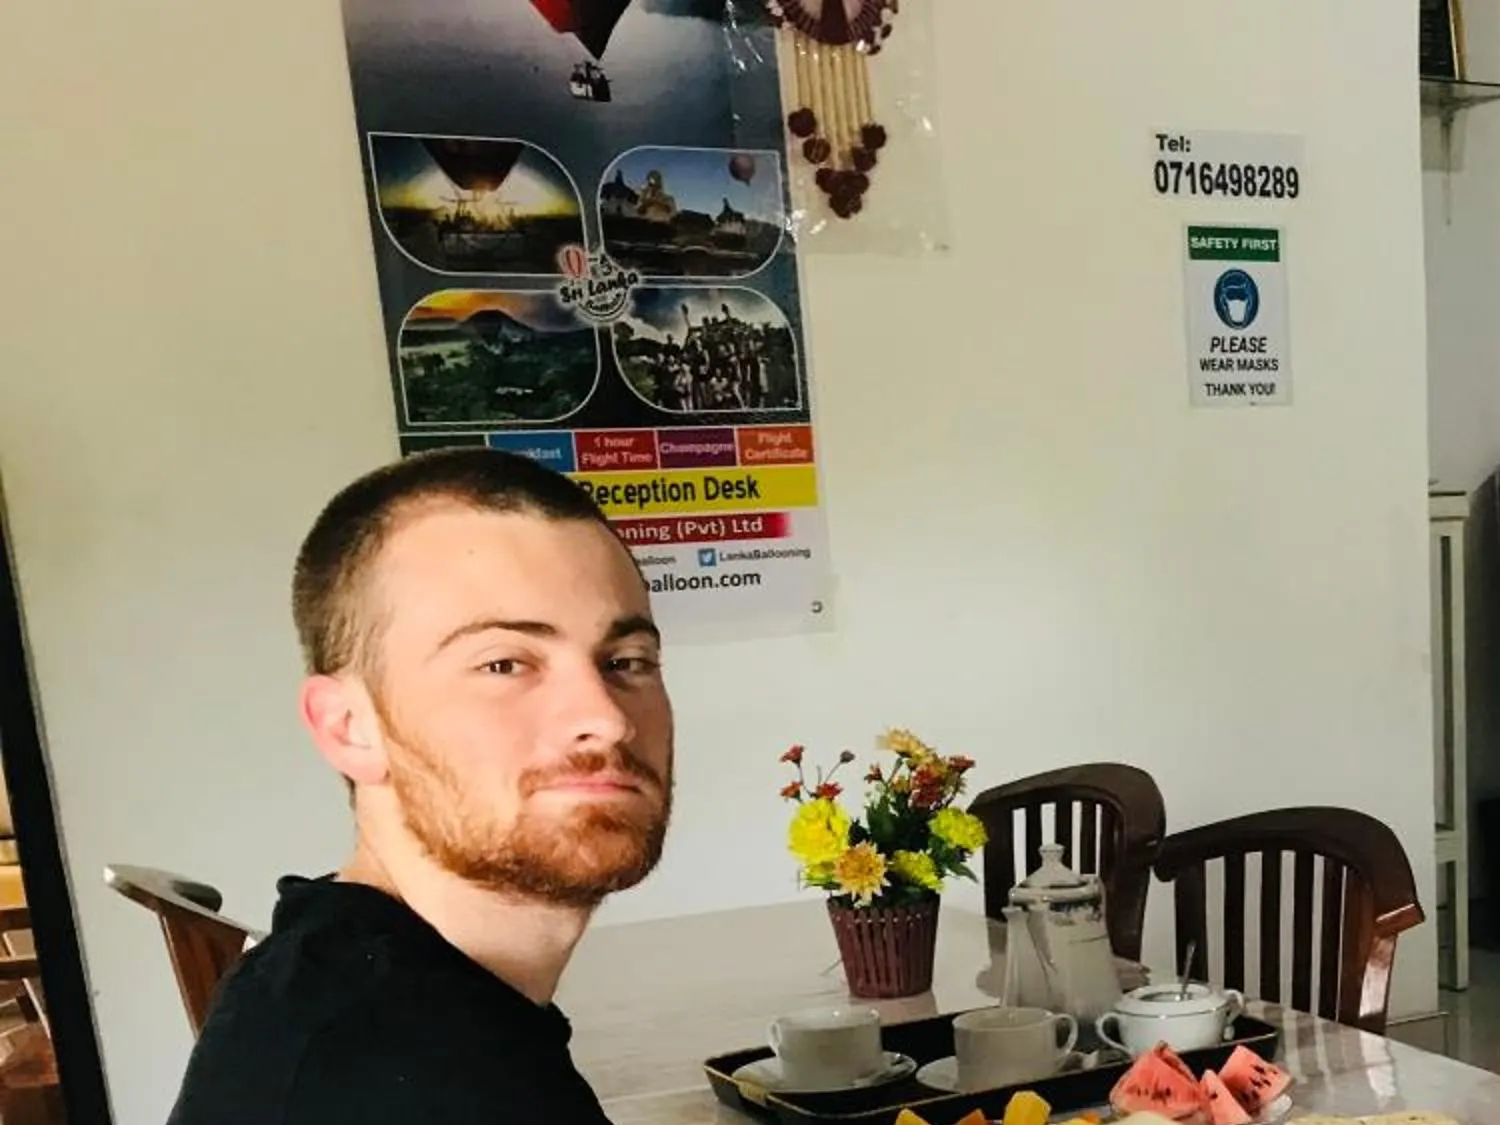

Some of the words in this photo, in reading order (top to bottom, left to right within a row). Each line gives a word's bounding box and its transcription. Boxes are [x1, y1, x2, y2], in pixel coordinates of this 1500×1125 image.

[1155, 133, 1191, 153] Tel:
[1154, 159, 1299, 199] 0716498289
[1190, 236, 1239, 250] SAFETY
[1242, 238, 1277, 251] FIRST
[1209, 335, 1267, 353] PLEASE
[1199, 357, 1234, 372] WEAR
[1236, 358, 1279, 372] MASKS
[1204, 382, 1246, 397] THANK
[603, 436, 635, 448] hour
[758, 431, 793, 446] Flight
[660, 442, 733, 456] Champagne
[581, 451, 619, 468] Flight
[621, 450, 654, 465] Time
[703, 474, 761, 500] Desk
[677, 519, 726, 540] (Pvt)
[732, 516, 763, 534] Ltd
[647, 571, 762, 593] alloon.com
